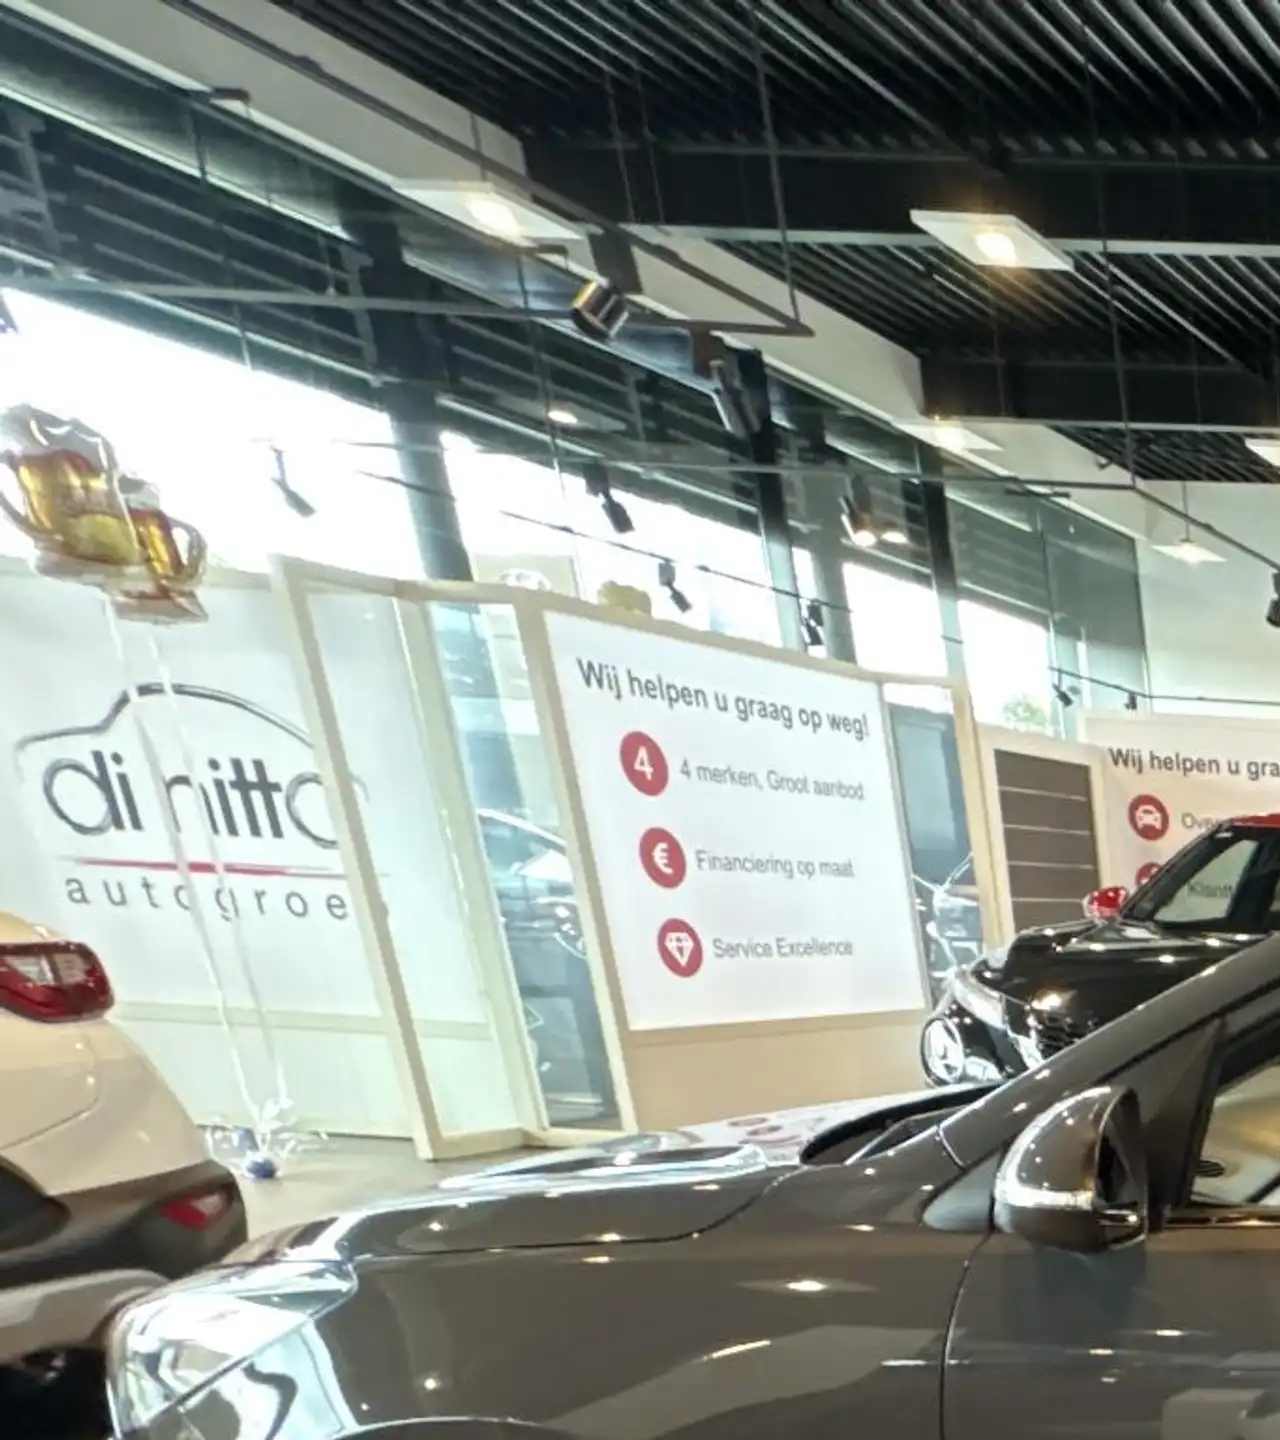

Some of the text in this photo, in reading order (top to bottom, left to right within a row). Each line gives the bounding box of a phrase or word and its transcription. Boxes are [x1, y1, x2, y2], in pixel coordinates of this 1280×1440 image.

[576, 657, 869, 742] Wij helpen u graag op weg!
[633, 745, 654, 780] 4
[680, 757, 865, 800] 4 merken, Groot aanbod
[1107, 747, 1143, 773] Wij
[1150, 751, 1221, 776] helpen
[1228, 760, 1240, 775] u
[43, 749, 144, 836] di
[695, 850, 855, 878] Financiering op maat
[65, 876, 349, 922] autogroe
[712, 937, 853, 958] Service Excellence
